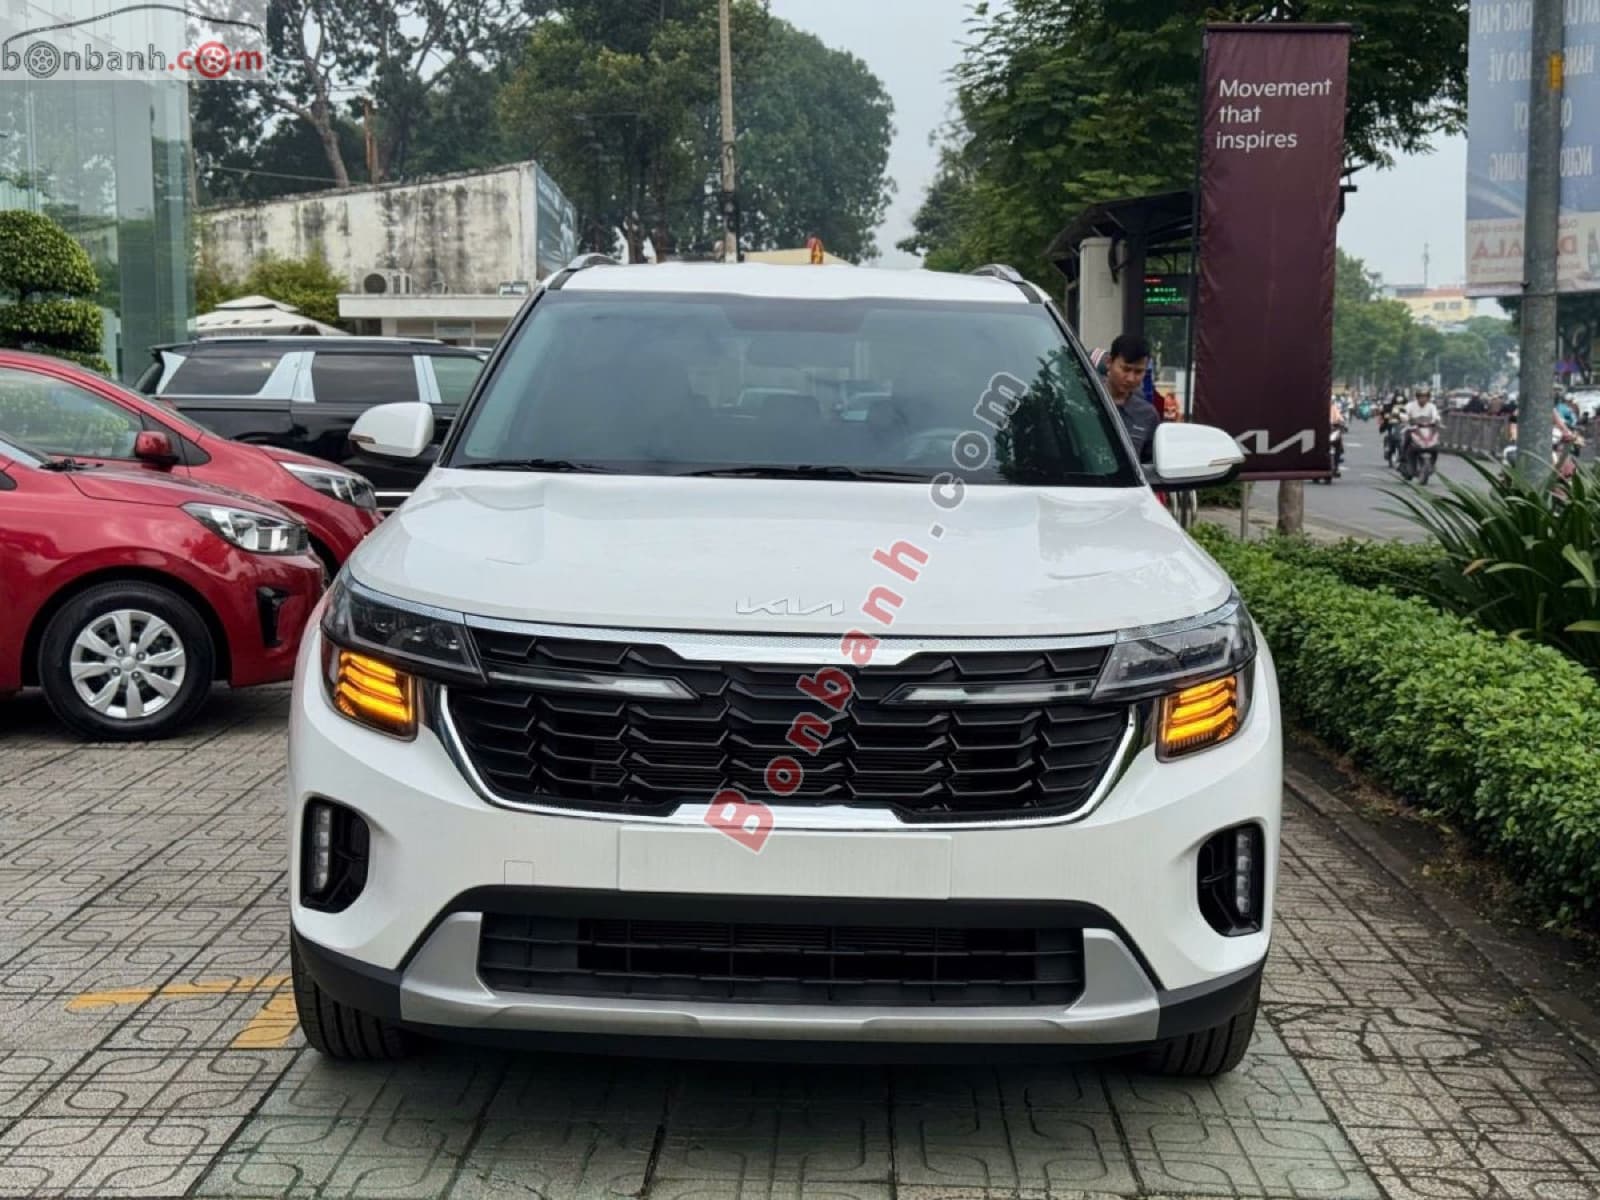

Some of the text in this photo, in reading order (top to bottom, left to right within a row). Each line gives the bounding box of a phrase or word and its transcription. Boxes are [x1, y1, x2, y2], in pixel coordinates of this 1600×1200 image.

[1219, 78, 1333, 97] Movement
[1218, 104, 1262, 124] that
[1216, 130, 1298, 153] inspires
[735, 593, 845, 617] KIA
